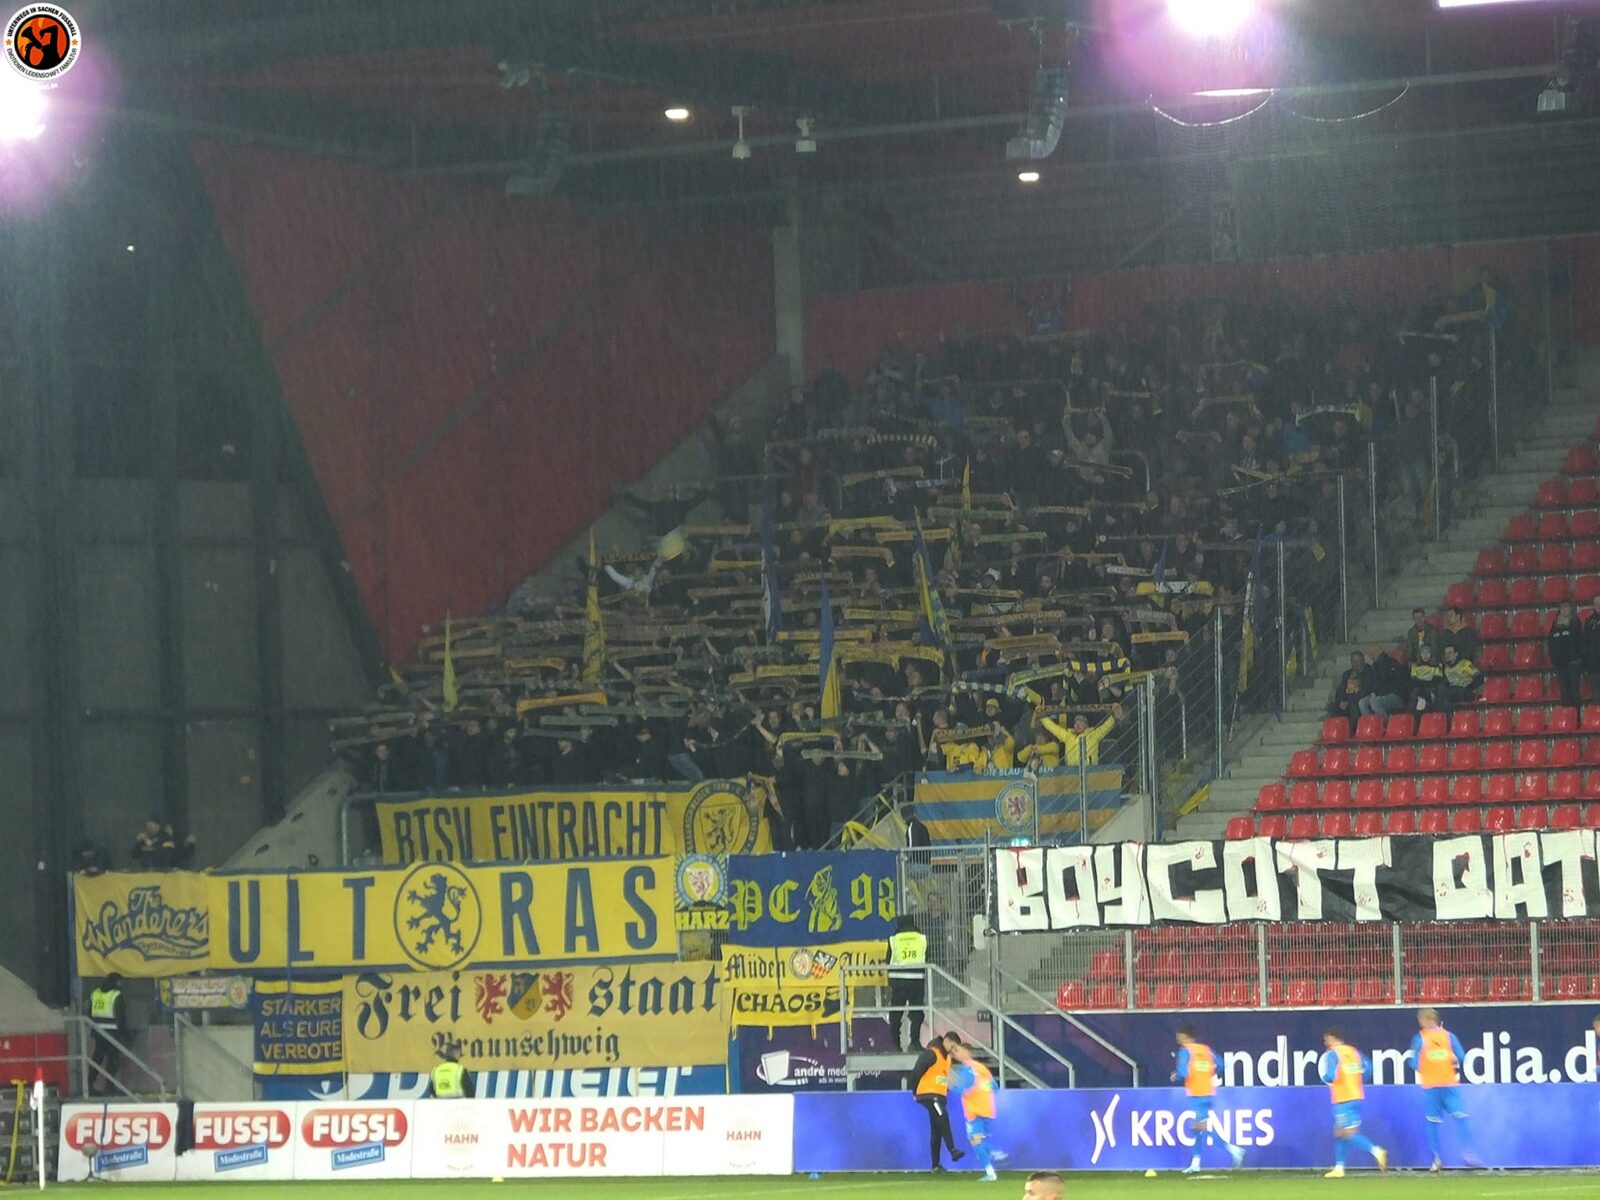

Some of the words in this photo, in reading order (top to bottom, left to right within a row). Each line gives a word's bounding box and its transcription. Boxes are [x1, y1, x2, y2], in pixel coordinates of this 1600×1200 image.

[393, 806, 473, 863] BTSV
[490, 800, 666, 861] EINTRACHT
[996, 835, 1393, 933] BOYCOTT
[675, 910, 730, 930] HARZ
[736, 989, 821, 1014] CHAOS
[260, 1020, 294, 1038] ALS
[296, 1019, 342, 1038] EURE
[794, 1065, 825, 1077] andré
[76, 1117, 163, 1146] FUSSL
[196, 1115, 284, 1145] FUSSL
[312, 1113, 400, 1143] FUSSL
[508, 1108, 572, 1133] WIR
[580, 1106, 704, 1132] BACKEN
[444, 1133, 479, 1144] HAHN
[726, 1130, 762, 1141] HAHN
[507, 1142, 608, 1168] NATUR
